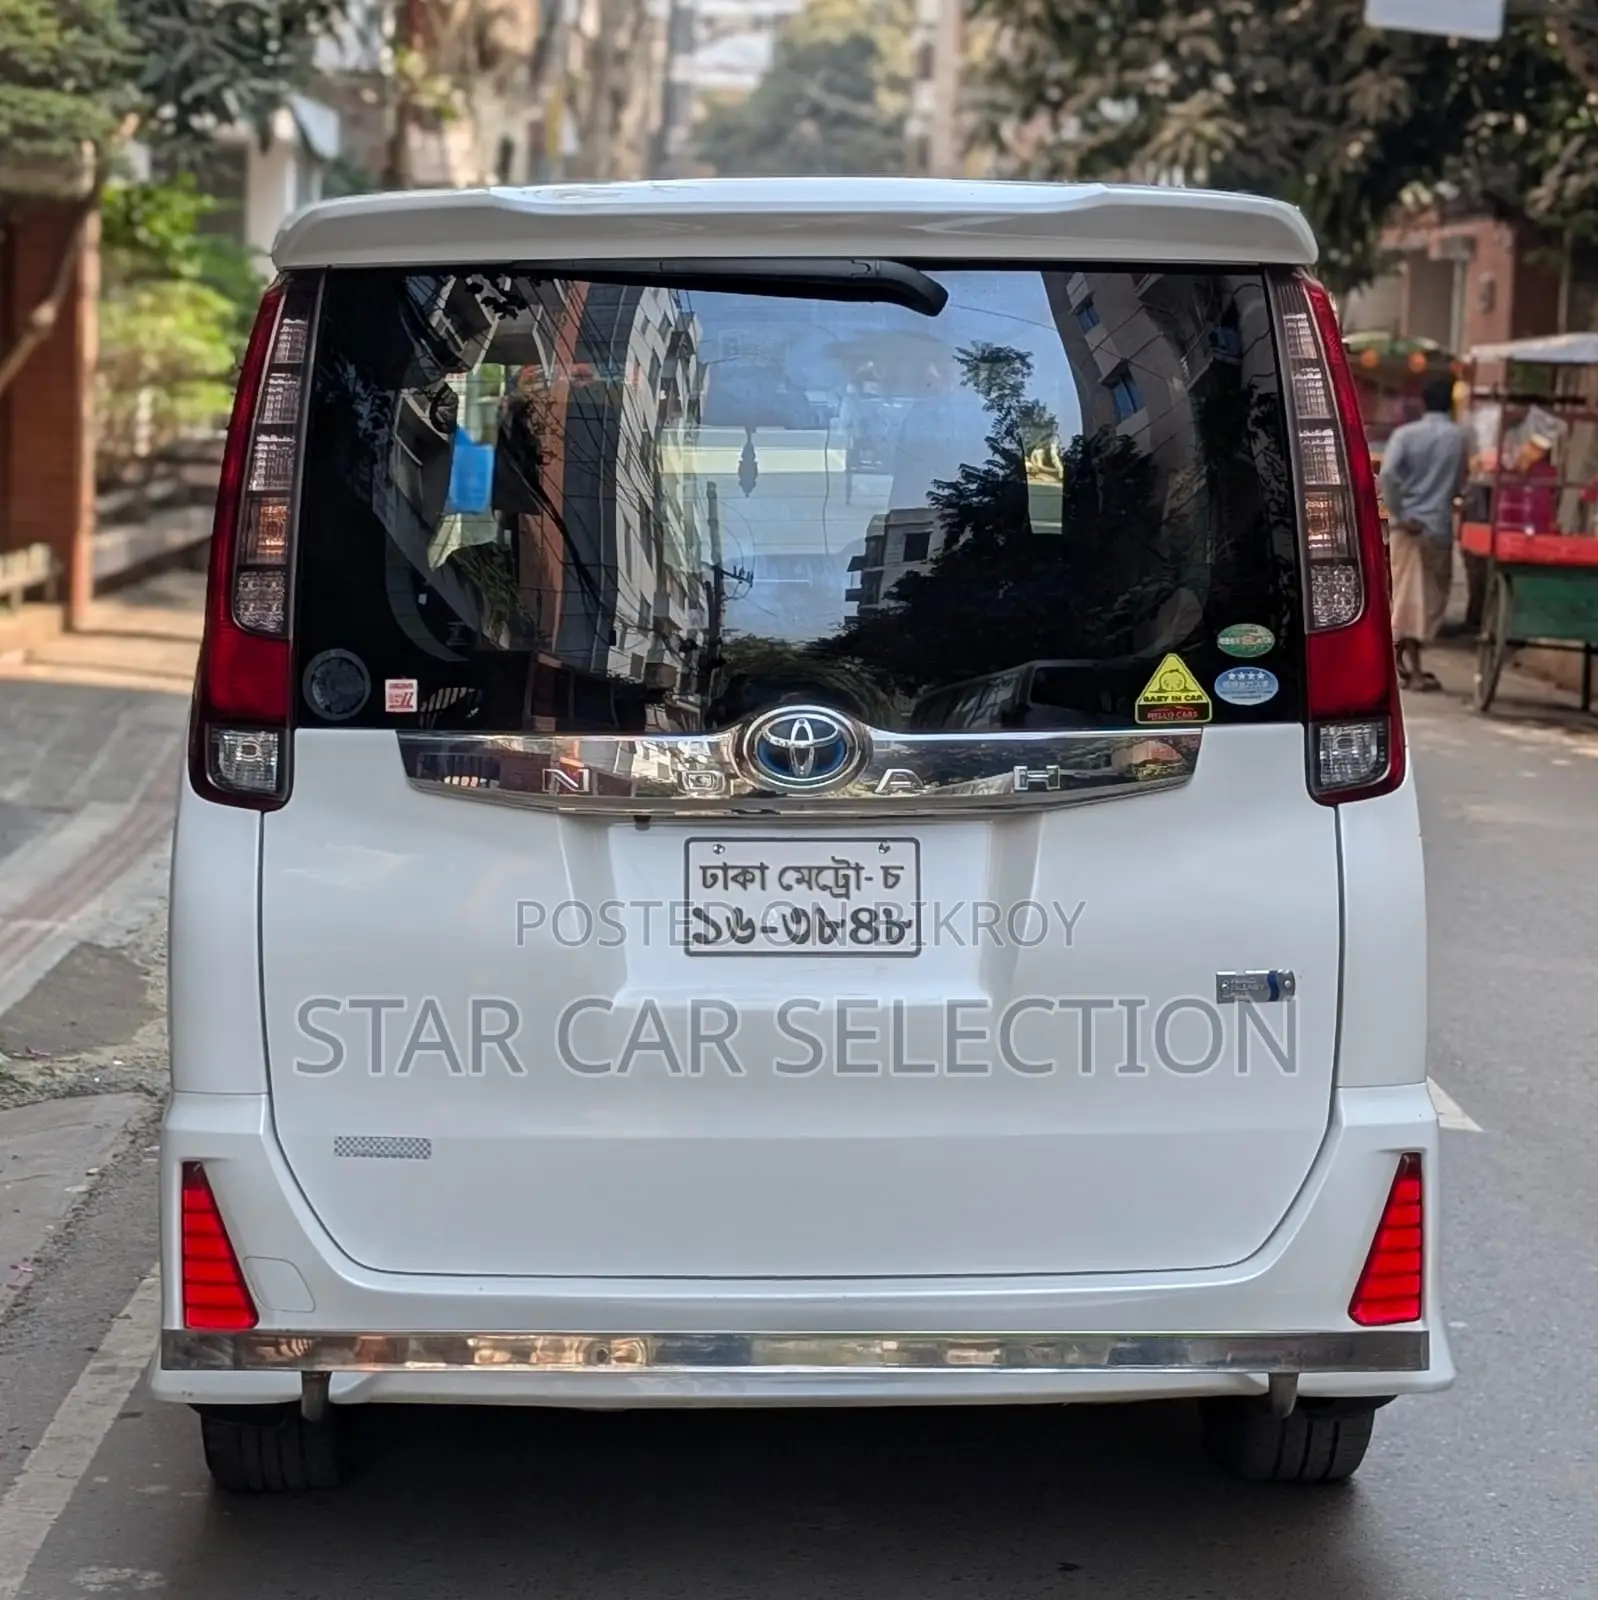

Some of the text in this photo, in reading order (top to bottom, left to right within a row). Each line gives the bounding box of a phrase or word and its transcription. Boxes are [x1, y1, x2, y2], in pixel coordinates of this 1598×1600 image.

[699, 861, 770, 891] ঢাকা
[879, 865, 904, 890] চ
[692, 907, 913, 945] ১৬-৩৮৪৮
